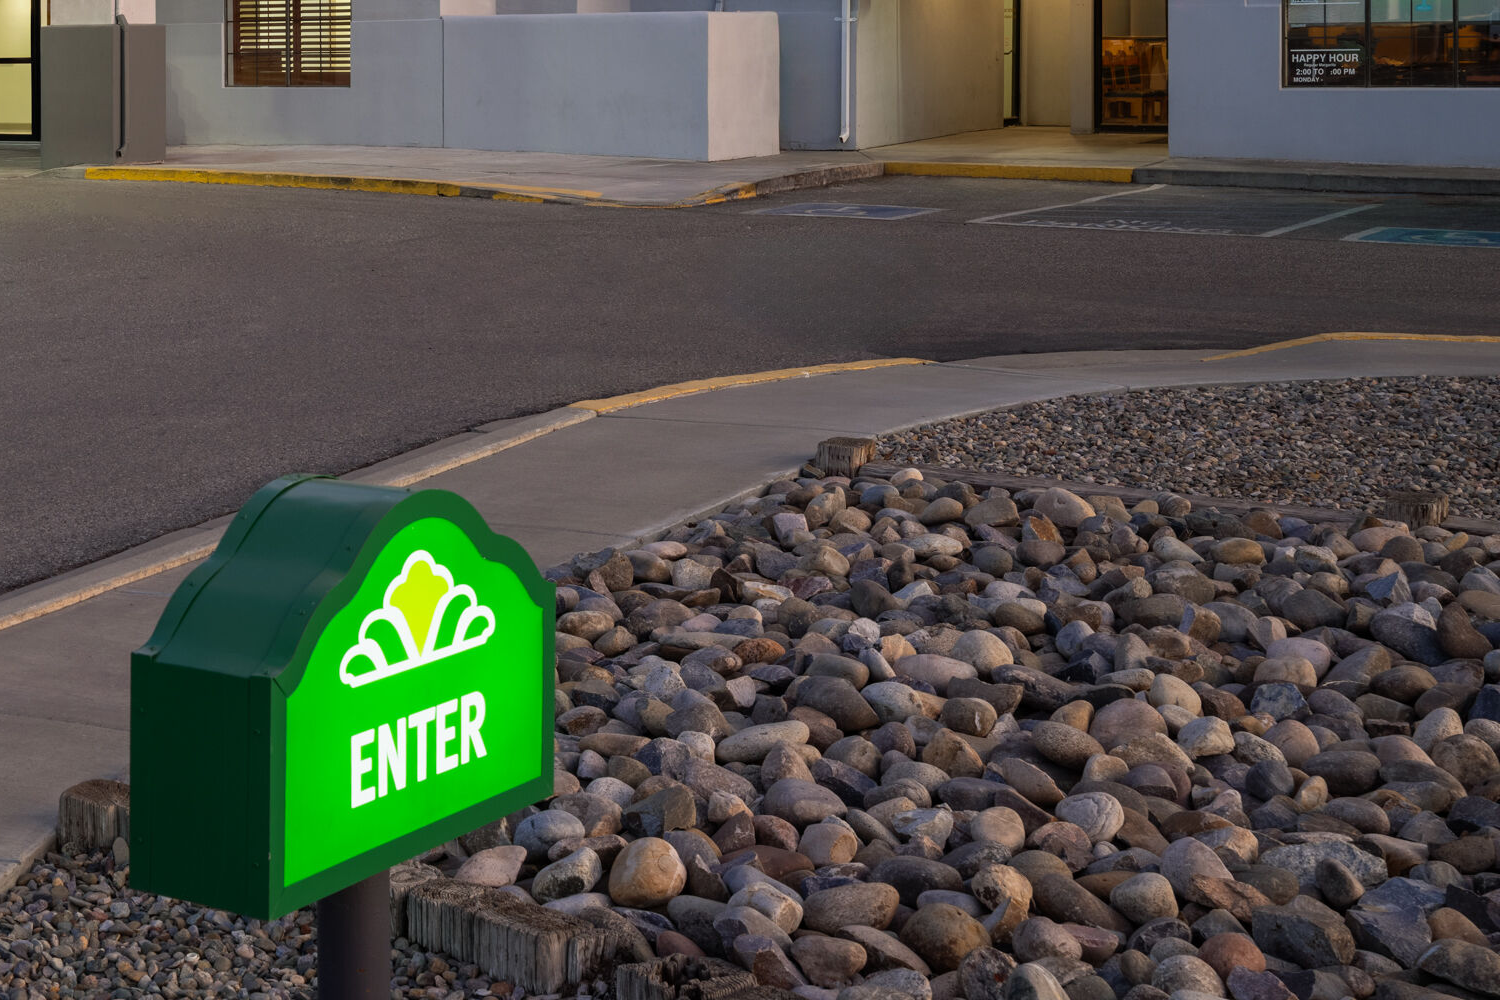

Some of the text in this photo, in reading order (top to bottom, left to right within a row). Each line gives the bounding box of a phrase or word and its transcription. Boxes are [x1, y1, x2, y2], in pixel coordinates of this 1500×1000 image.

[1291, 53, 1359, 62] HAPPY HOUR
[350, 690, 488, 809] ENTER
